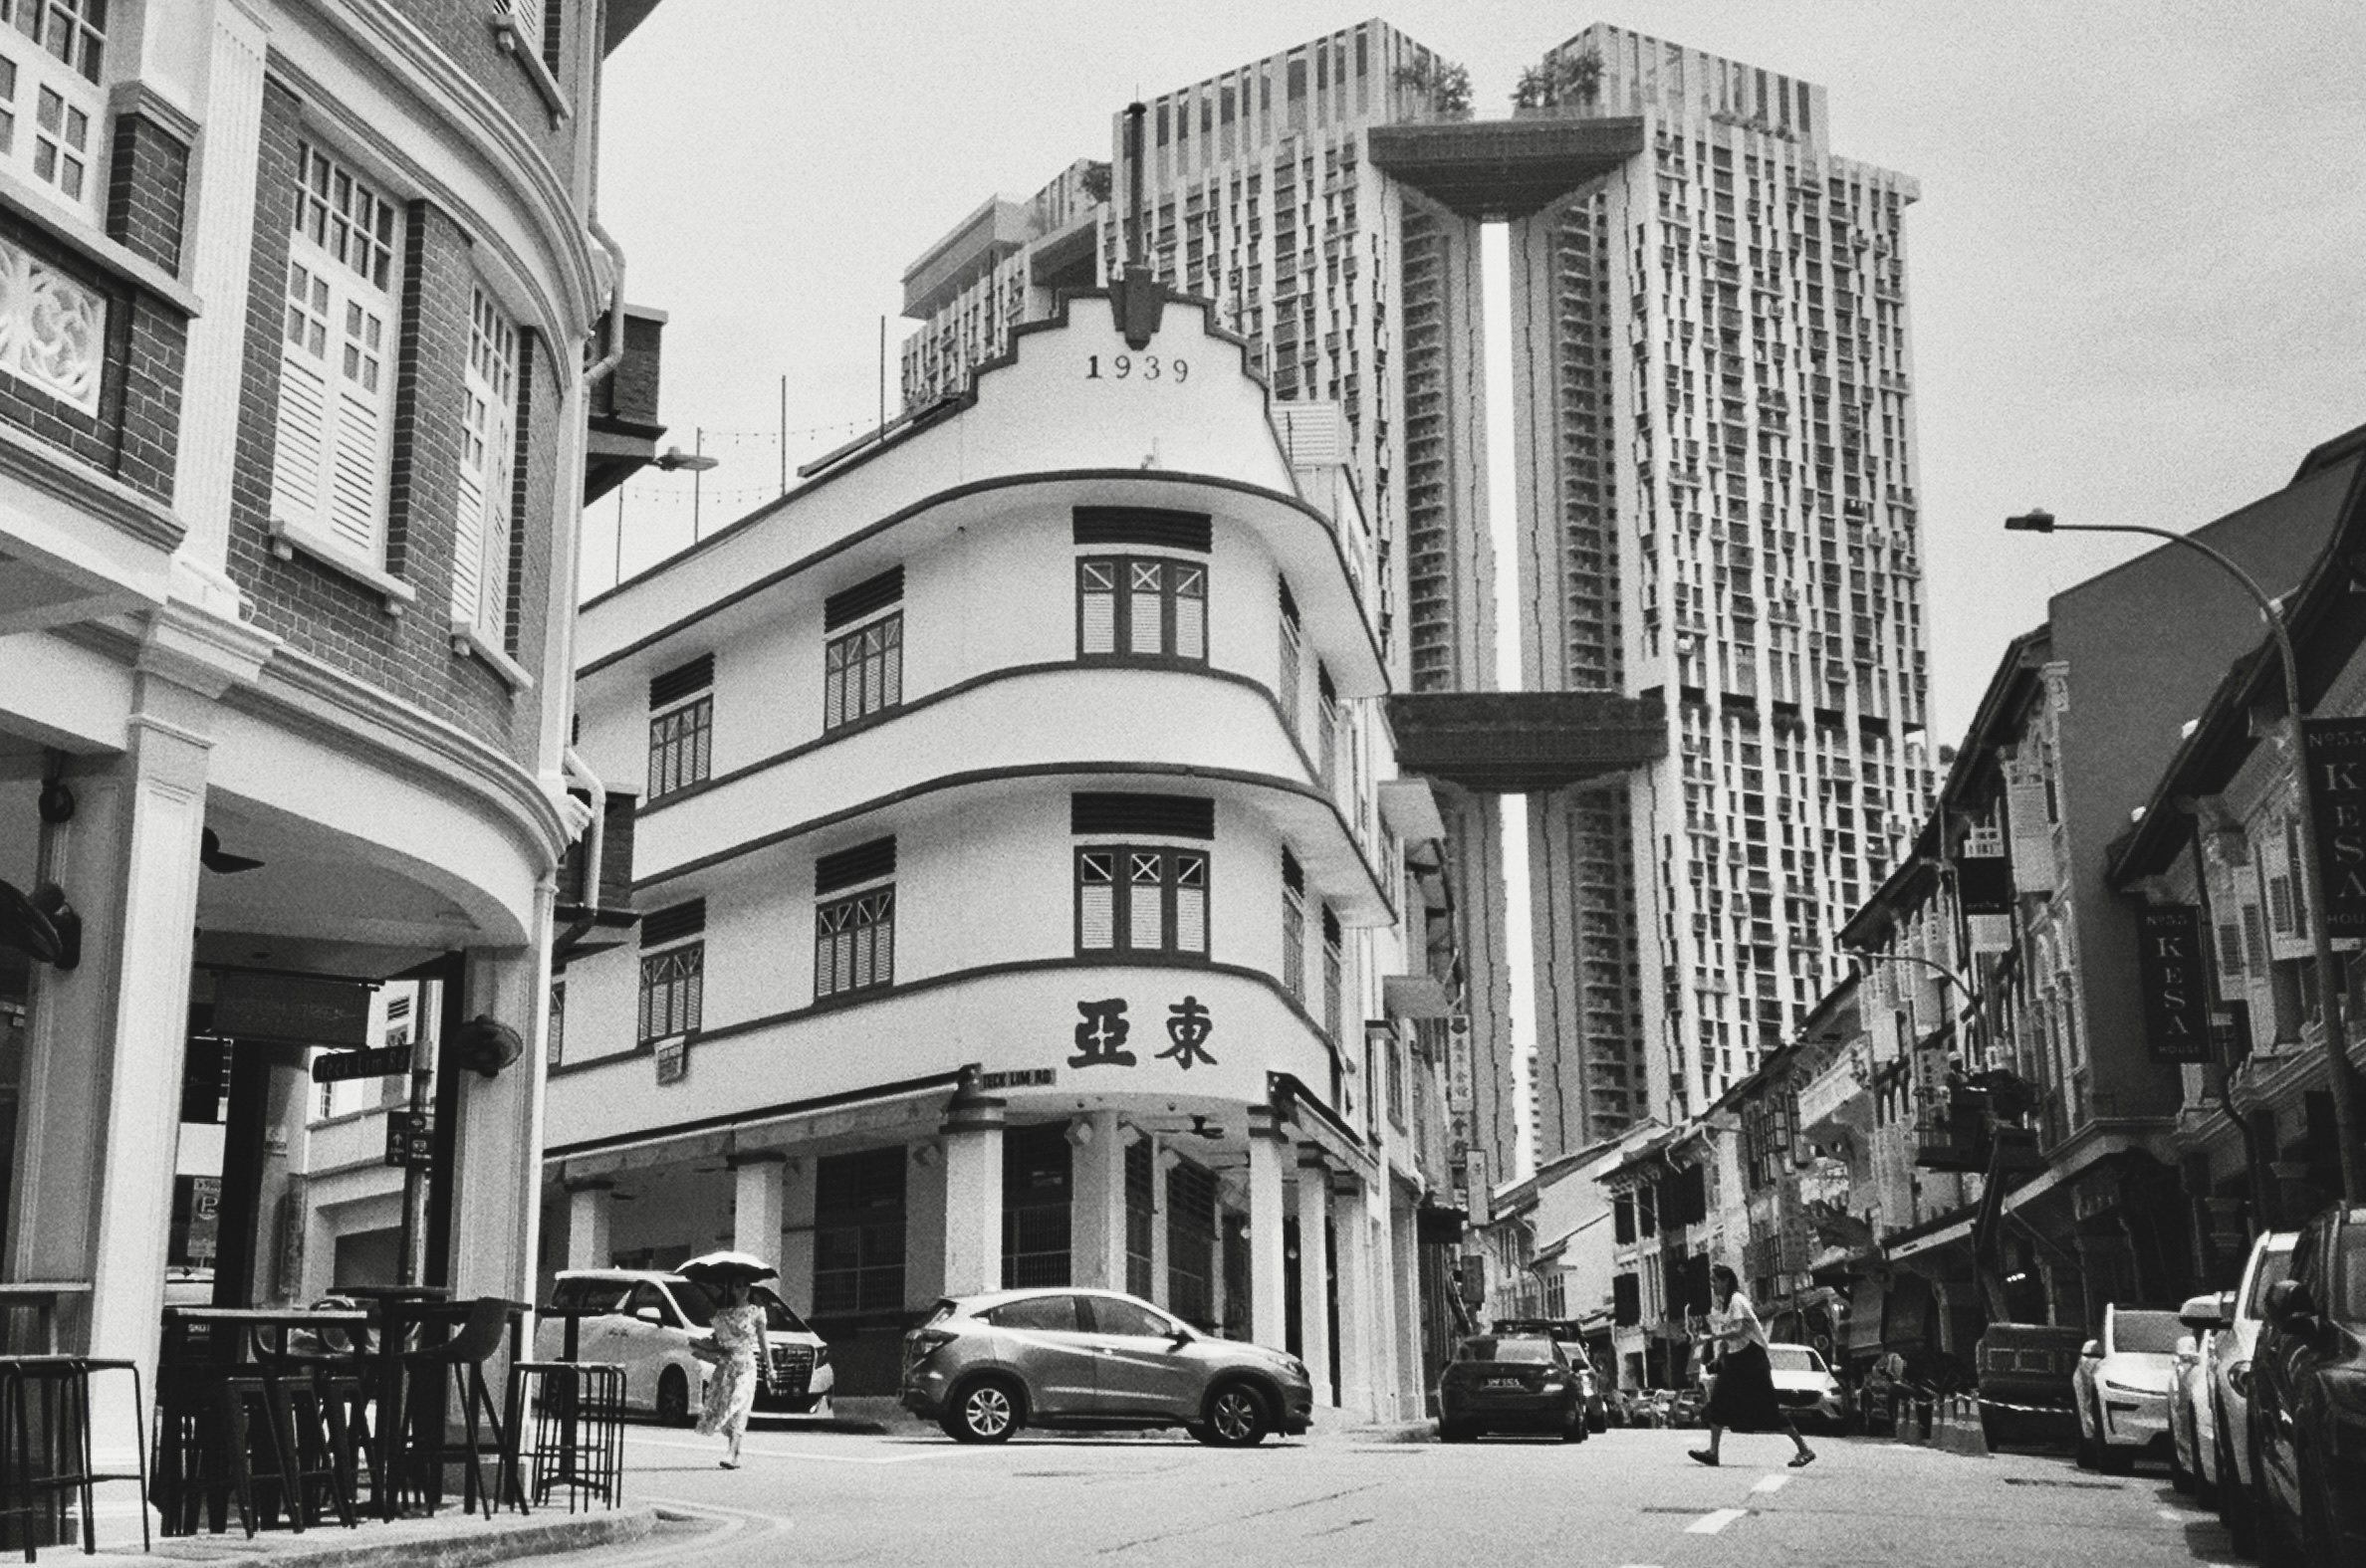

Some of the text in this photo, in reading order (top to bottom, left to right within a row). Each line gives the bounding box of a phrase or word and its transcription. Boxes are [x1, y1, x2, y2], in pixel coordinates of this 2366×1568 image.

[1085, 354, 1189, 383] 1939
[2156, 937, 2189, 1034] KESA
[387, 1049, 407, 1070] Rd
[983, 1068, 1052, 1089] TECK LIM RD
